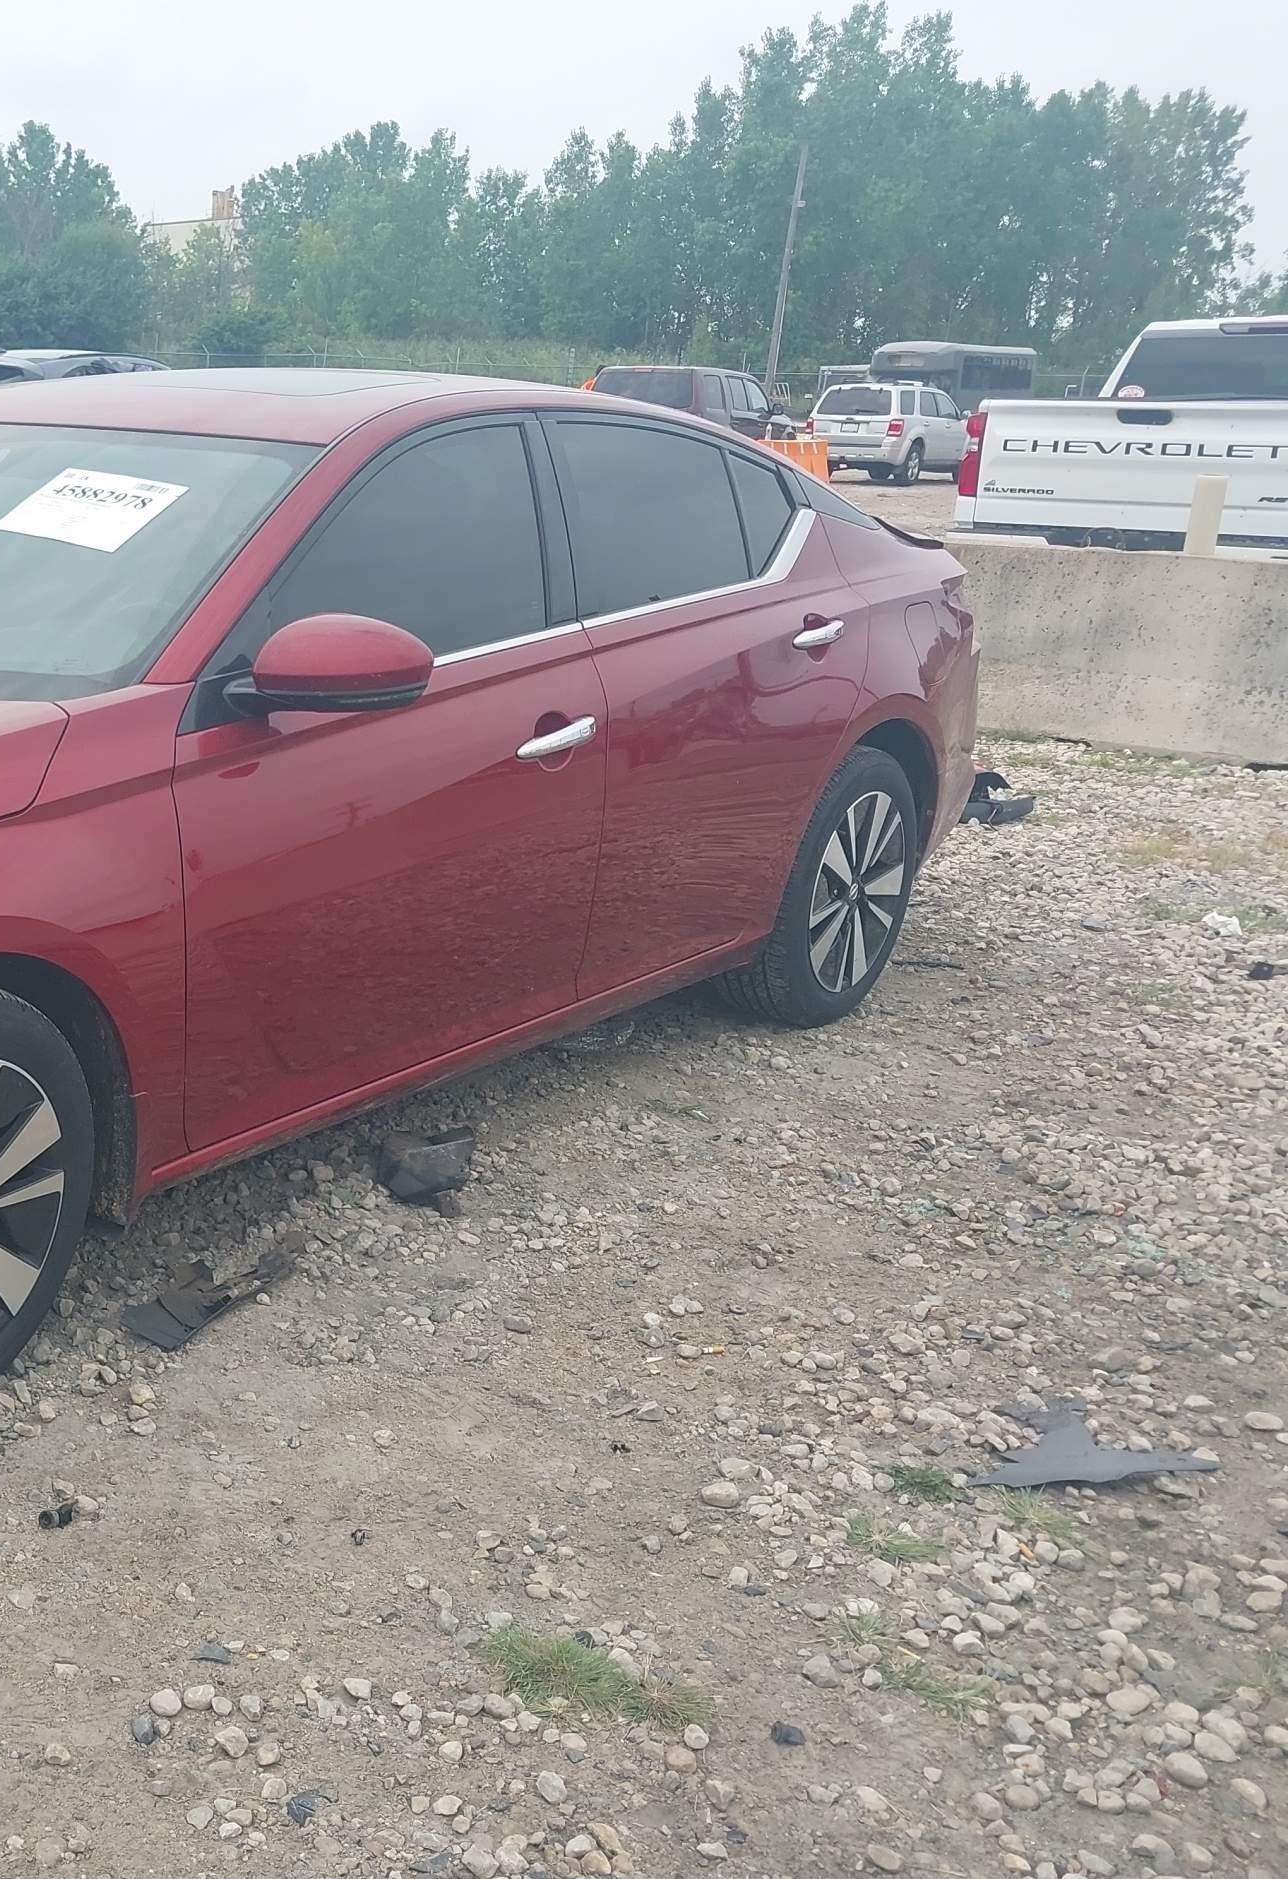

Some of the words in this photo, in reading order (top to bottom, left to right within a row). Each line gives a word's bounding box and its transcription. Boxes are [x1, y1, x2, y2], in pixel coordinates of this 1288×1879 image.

[1002, 439, 1288, 459] CHEVROLET
[53, 484, 152, 509] 45882978
[983, 486, 1054, 495] SILVERADO
